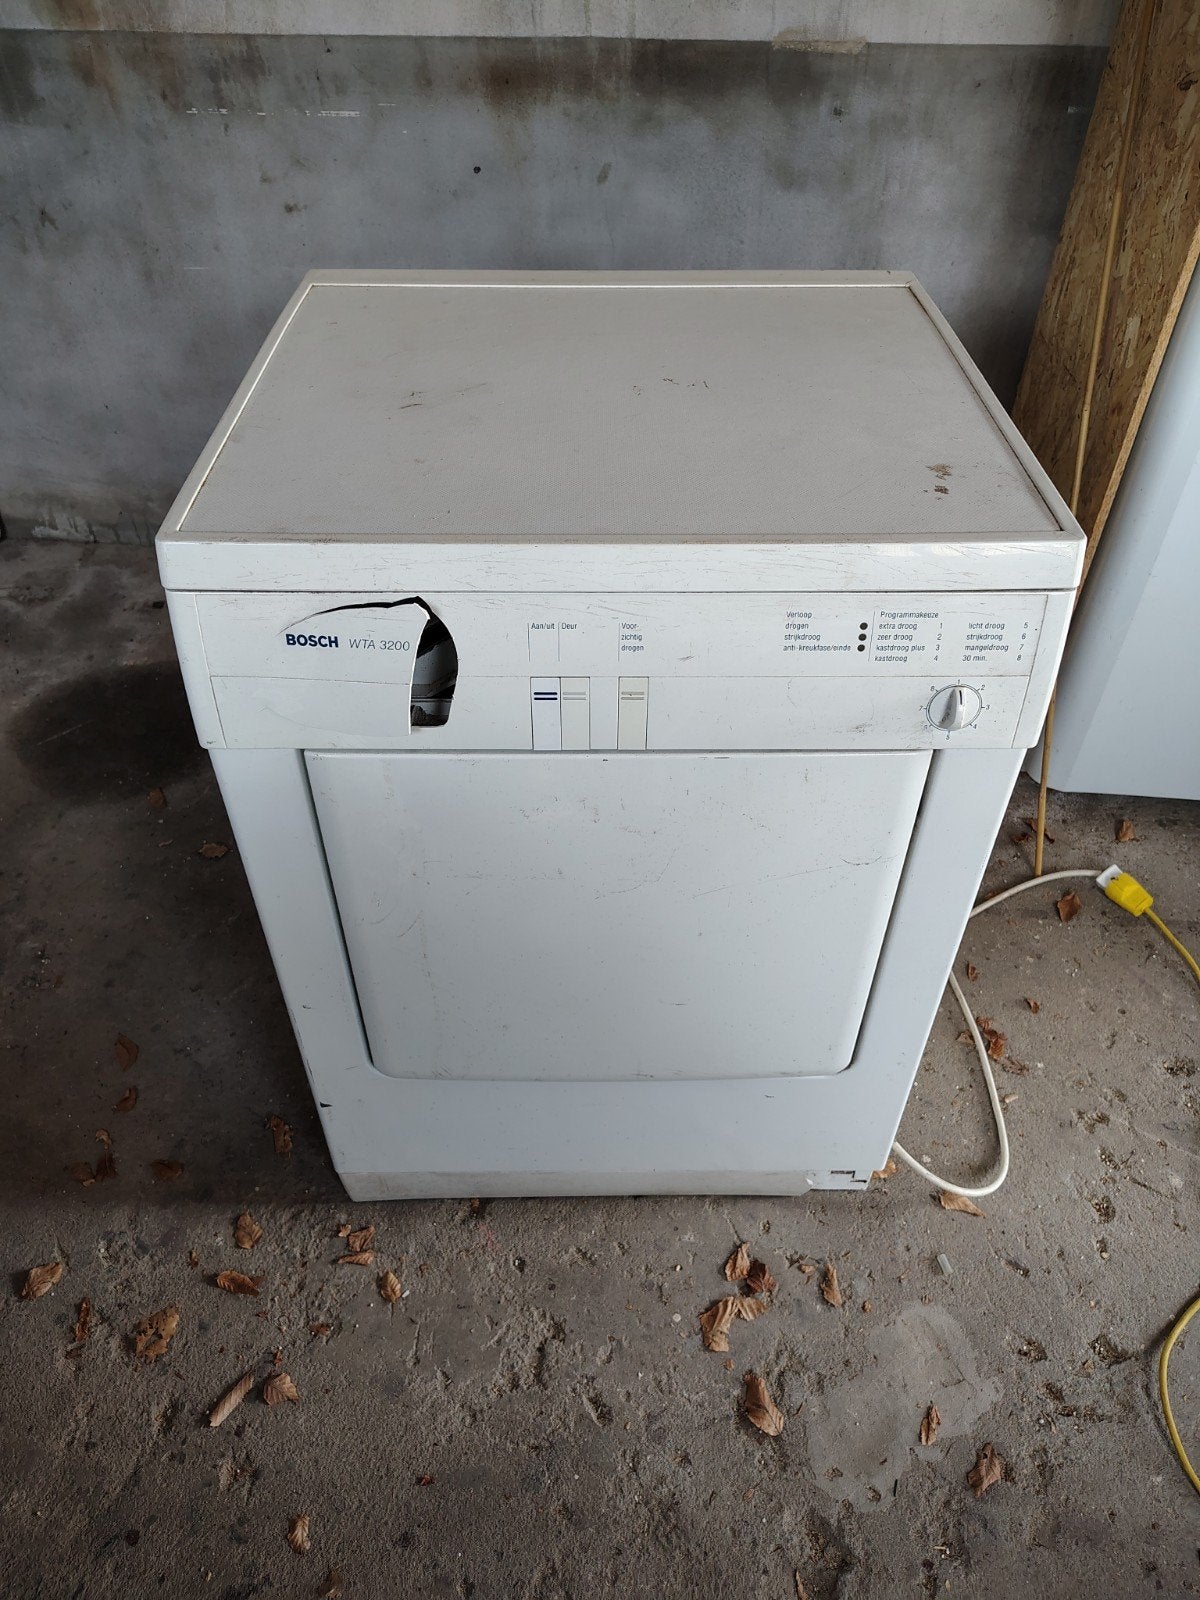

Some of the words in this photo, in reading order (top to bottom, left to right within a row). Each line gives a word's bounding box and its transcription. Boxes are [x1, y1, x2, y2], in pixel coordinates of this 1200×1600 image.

[786, 611, 812, 619] Verloop
[531, 622, 555, 630] Aan/uit
[561, 622, 577, 630] Deur
[621, 622, 639, 630] Voor-
[984, 622, 1005, 630] droog
[621, 633, 643, 641] zichtig
[286, 633, 339, 648] BOSCH
[349, 638, 375, 649] WTA
[380, 640, 410, 651] 3200
[621, 644, 645, 652] drogen
